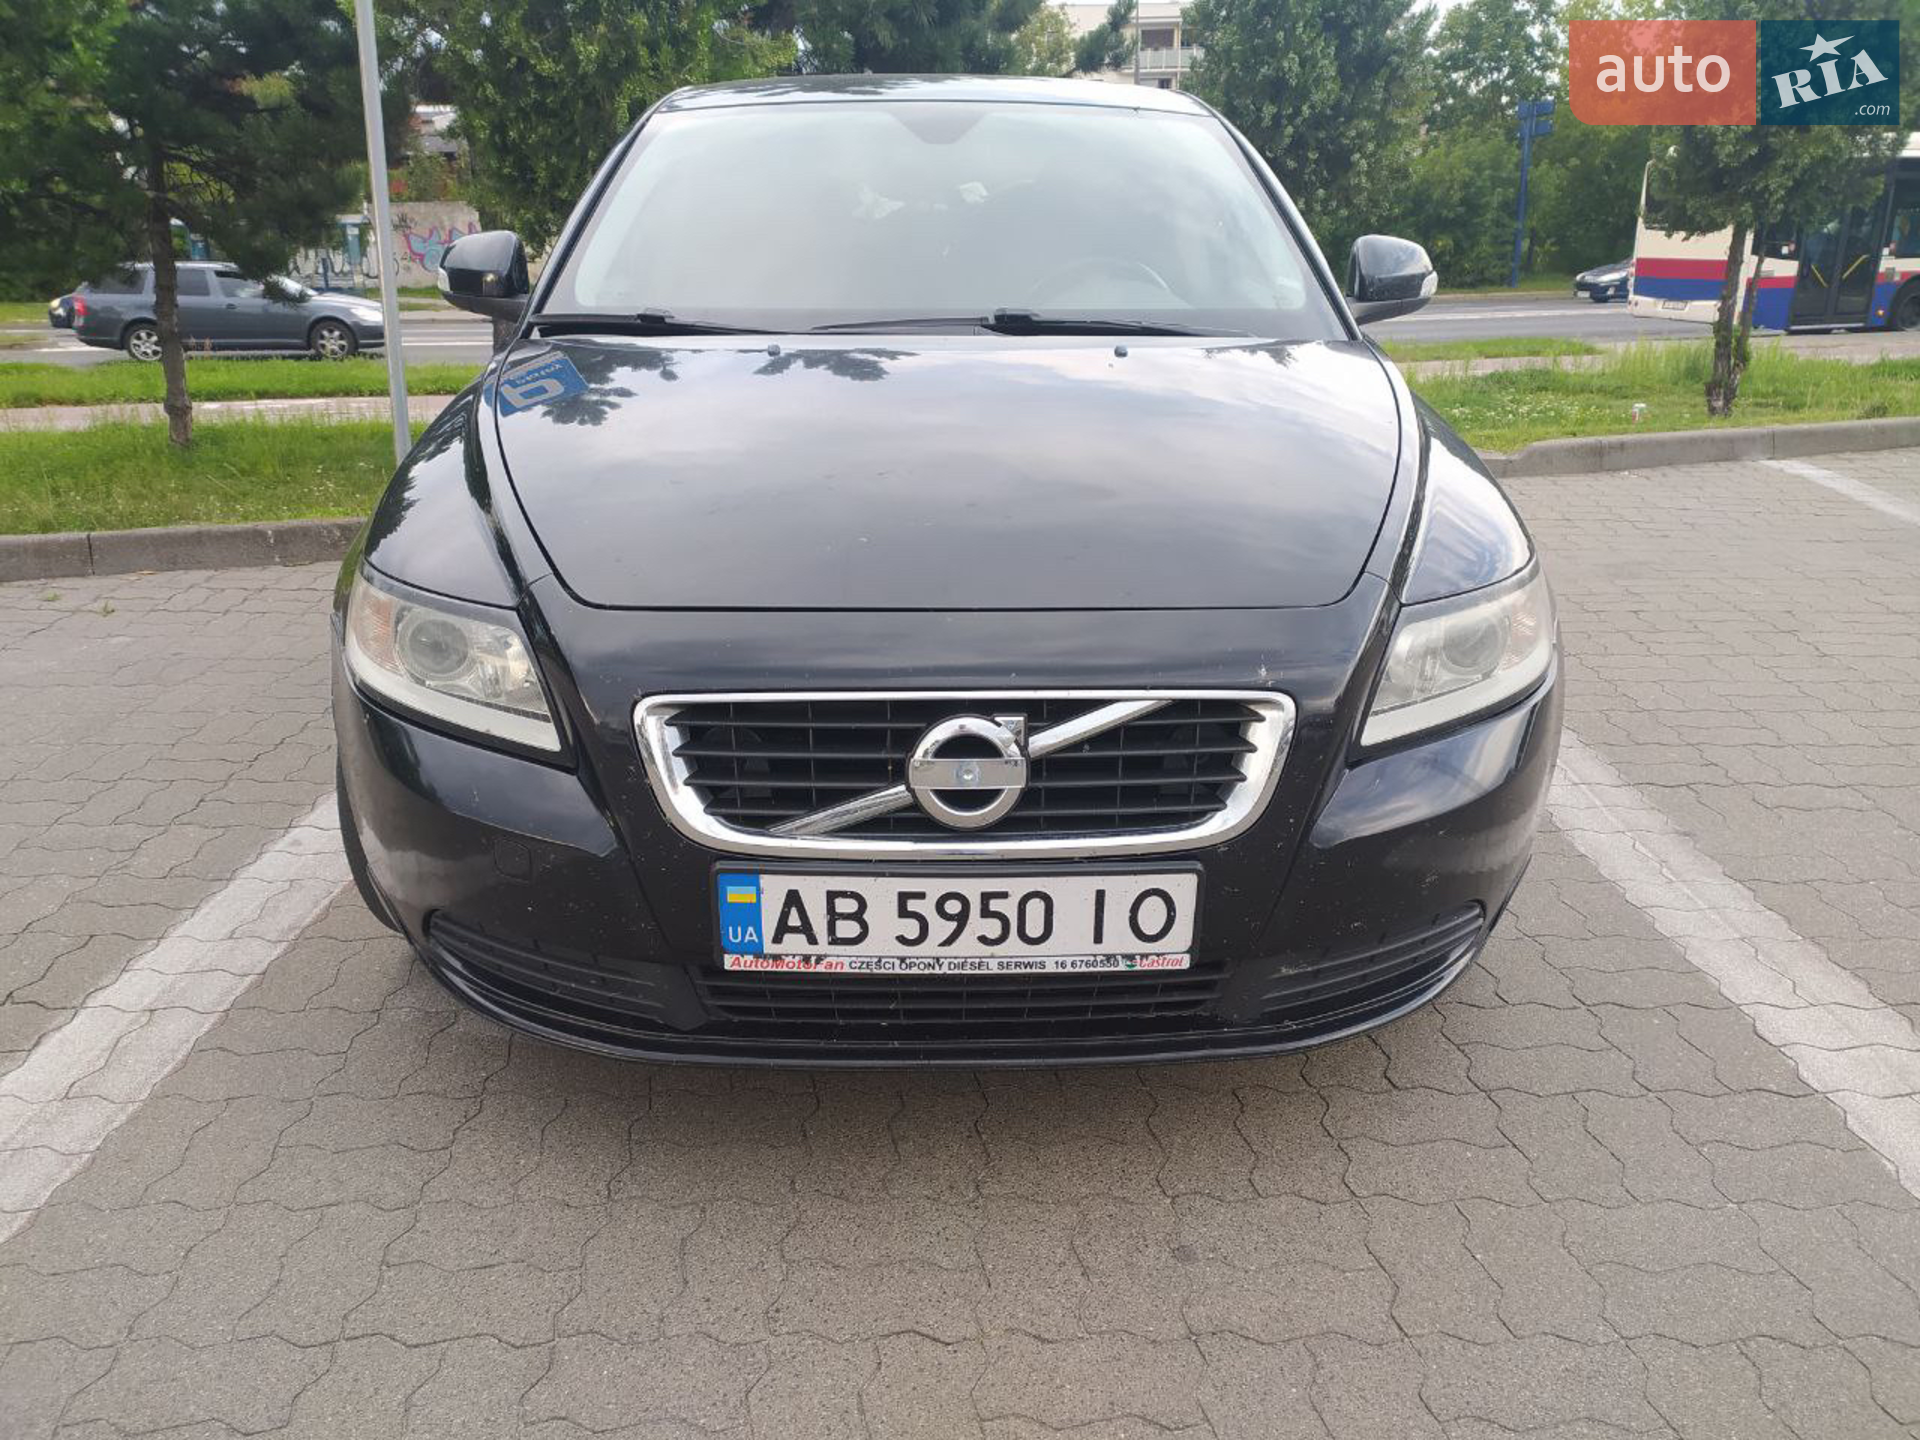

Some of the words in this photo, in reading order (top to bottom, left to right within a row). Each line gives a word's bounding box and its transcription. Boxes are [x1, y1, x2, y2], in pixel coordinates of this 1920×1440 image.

[771, 889, 870, 946] AB
[895, 890, 1054, 947] 5950
[728, 926, 759, 944] UA
[899, 959, 945, 971] OPONY
[948, 959, 993, 971] DIESEL
[997, 959, 1047, 971] SERWIS
[1054, 959, 1068, 970] 16
